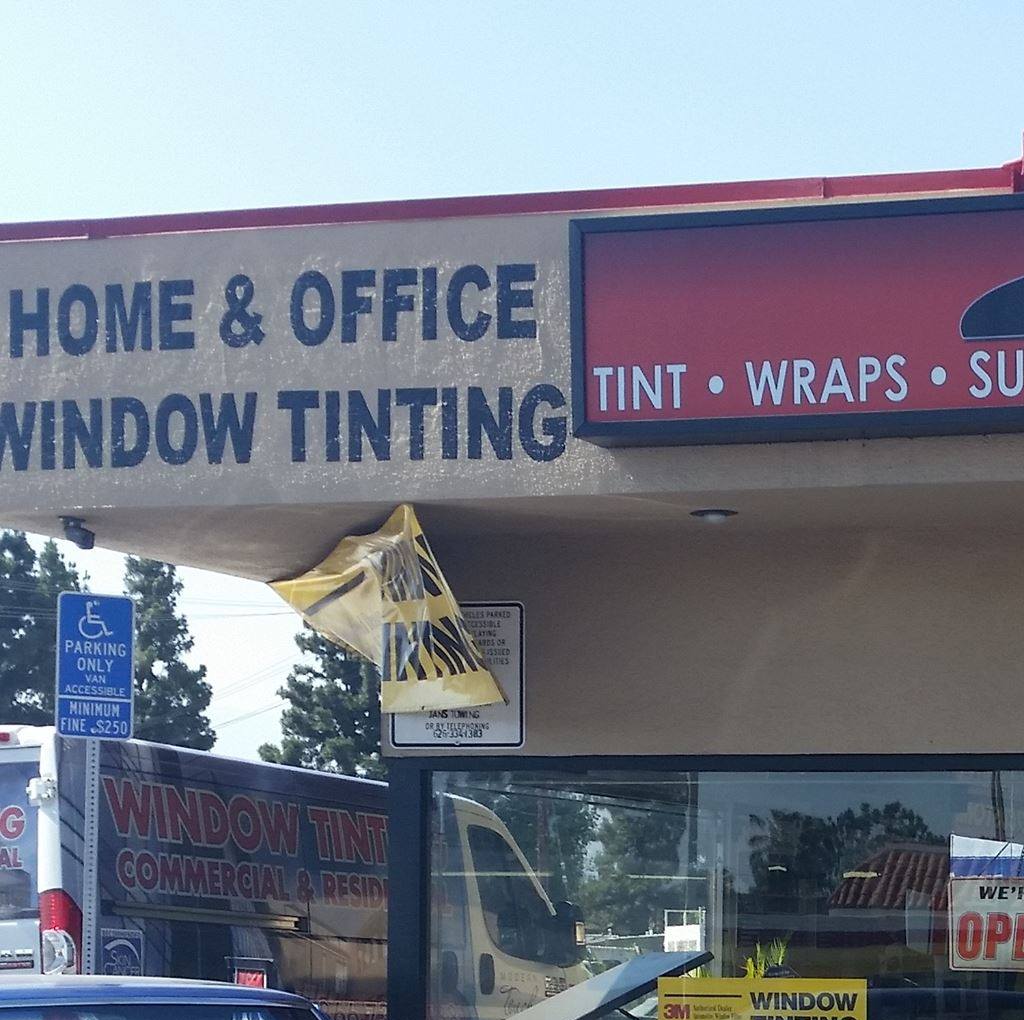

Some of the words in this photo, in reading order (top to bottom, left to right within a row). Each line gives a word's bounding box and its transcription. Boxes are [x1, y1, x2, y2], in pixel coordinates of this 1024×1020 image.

[9, 279, 196, 358] HOME
[219, 273, 266, 347] &
[290, 263, 538, 347] OFFICE
[593, 363, 688, 412] TINT
[745, 353, 909, 407] WRAPS
[0, 391, 258, 472] WINDOW
[277, 383, 568, 463] TINTING
[65, 639, 127, 658] PARKING
[77, 657, 114, 673] ONLY
[85, 674, 106, 684] VAN
[64, 684, 127, 698] ACCESSIBLE
[69, 701, 120, 718] MINIMUM
[61, 717, 86, 732] FINE
[100, 775, 300, 859] WINDOW
[116, 847, 291, 902] COMMERCIAL
[296, 867, 316, 904] &
[663, 1003, 690, 1020] 3M
[749, 992, 859, 1012] WINDOW
